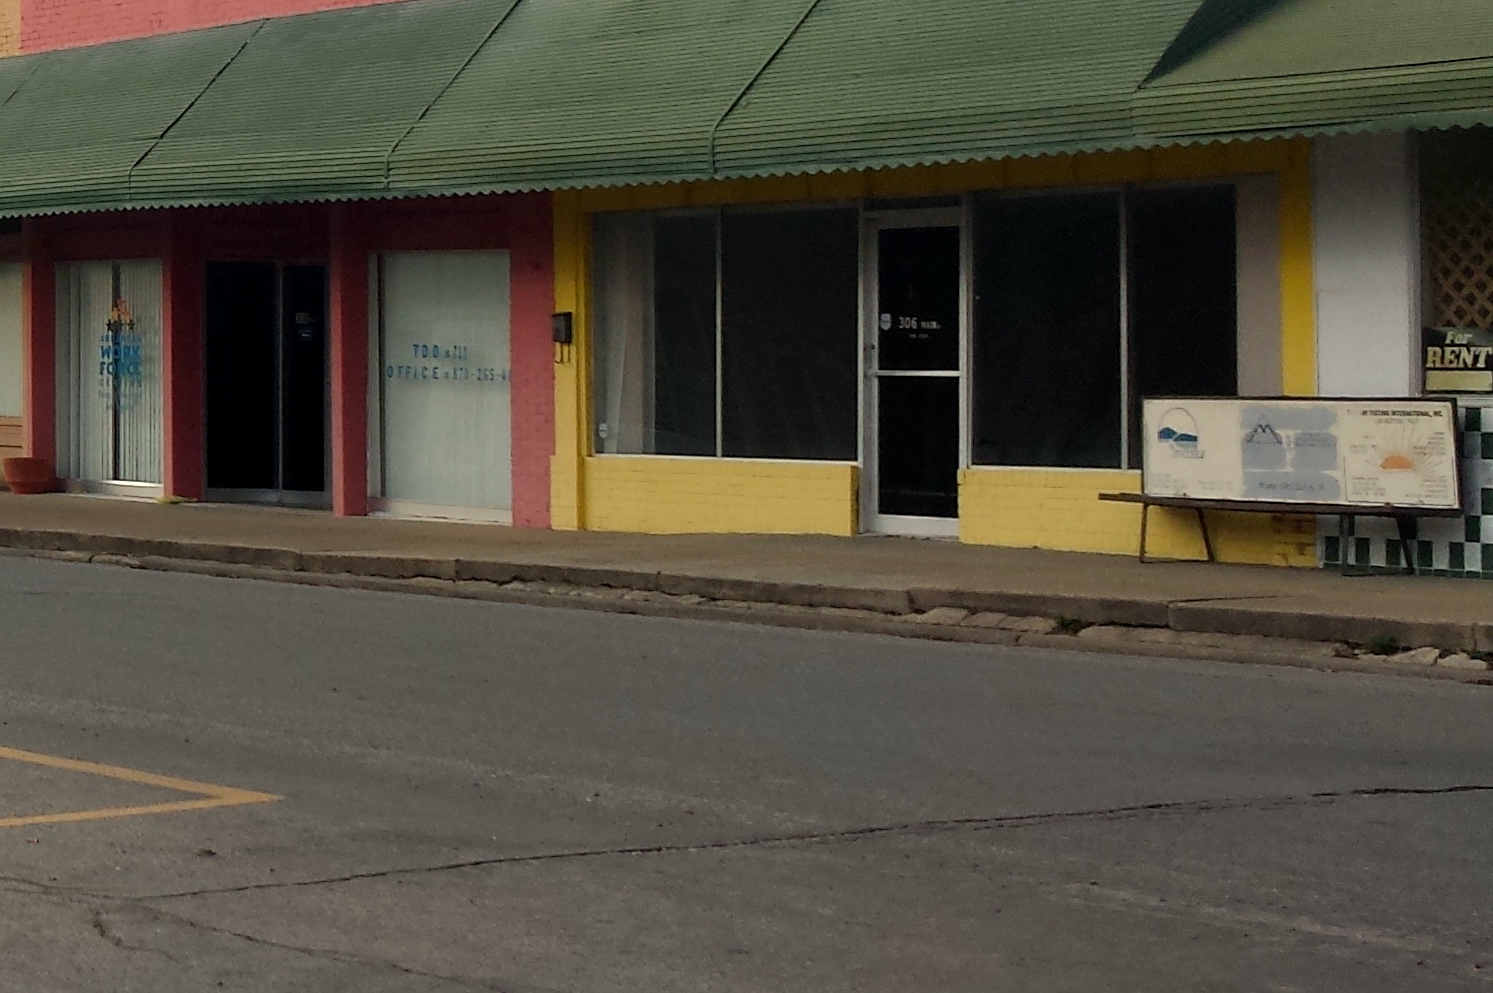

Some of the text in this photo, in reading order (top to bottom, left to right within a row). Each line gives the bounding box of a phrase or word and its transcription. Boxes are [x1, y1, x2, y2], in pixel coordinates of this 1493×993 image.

[898, 316, 917, 329] 306
[1445, 331, 1473, 344] For
[100, 345, 141, 360] WORK
[1426, 346, 1493, 368] RENT
[387, 366, 438, 380] OFFICE
